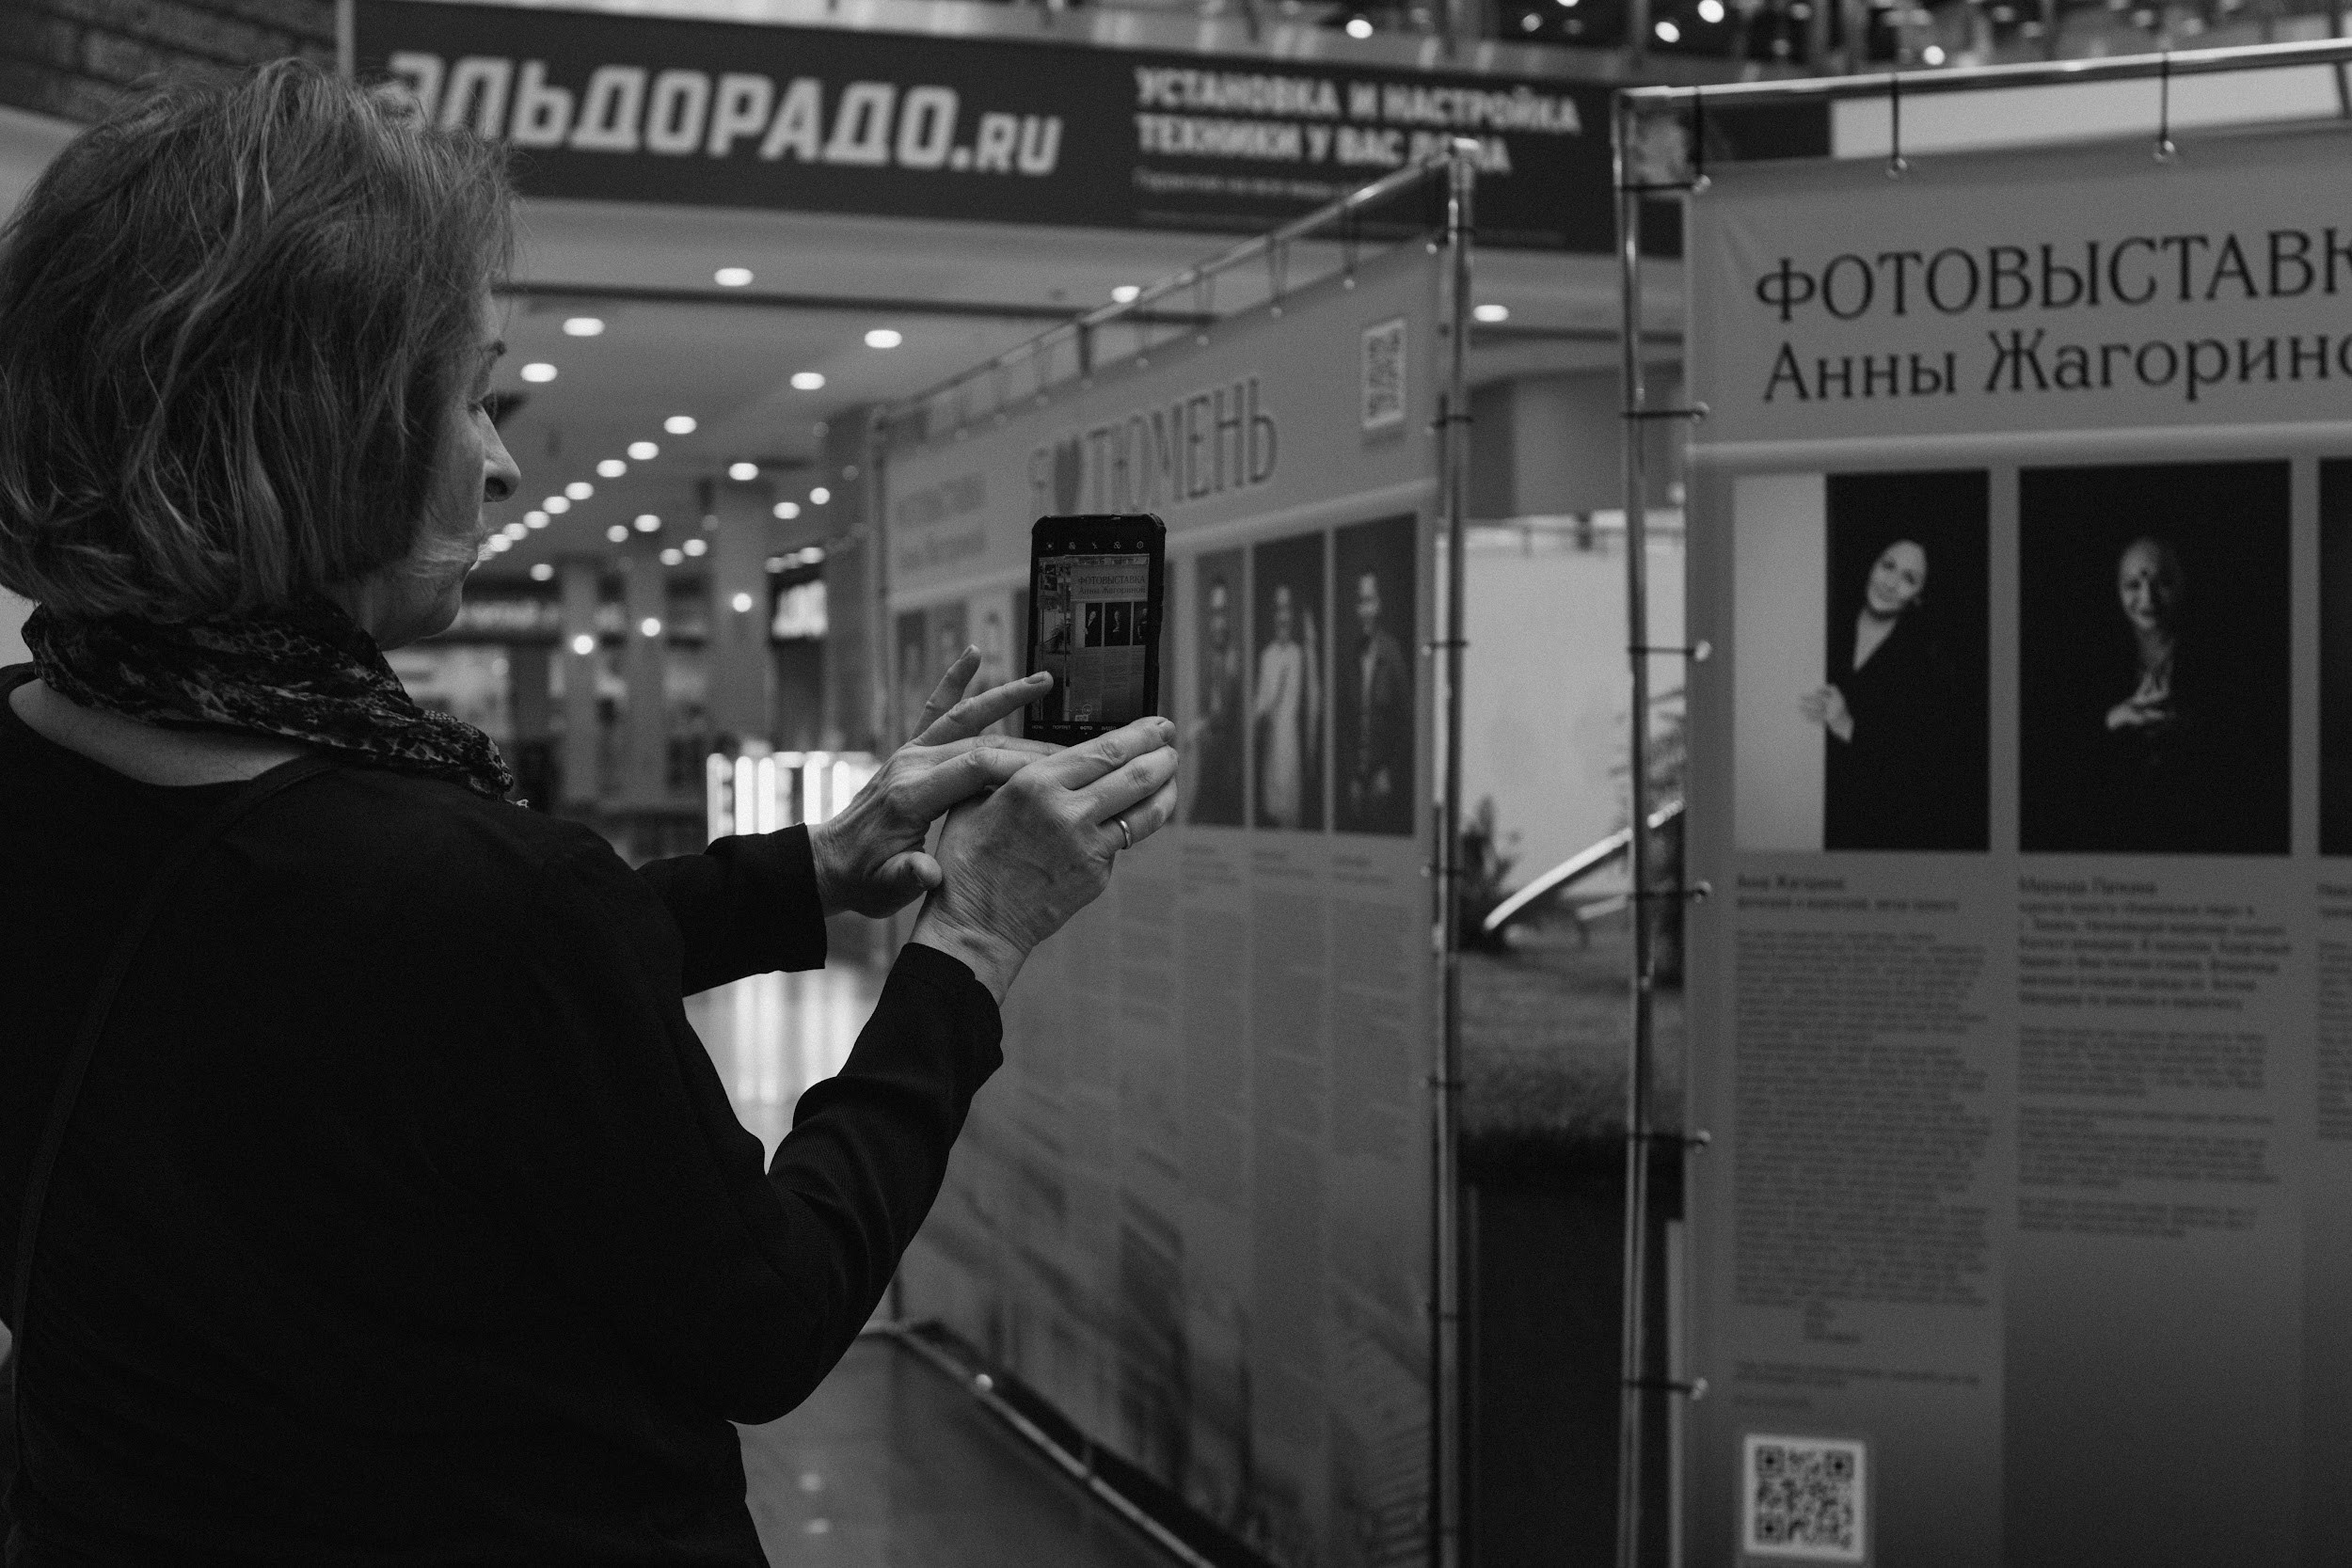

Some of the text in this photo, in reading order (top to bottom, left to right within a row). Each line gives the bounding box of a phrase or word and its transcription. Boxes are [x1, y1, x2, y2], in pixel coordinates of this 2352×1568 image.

[1135, 67, 1582, 135] УСТАНОВКА И НАСТРОЙКА
[1135, 113, 1512, 172] ТЕХНИКИ У ВАС ДА
[1762, 341, 1957, 403] Анны
[1078, 576, 1145, 584] ФОТОВЫСТАВКА
[1079, 587, 1146, 595] Анны Жагориной
